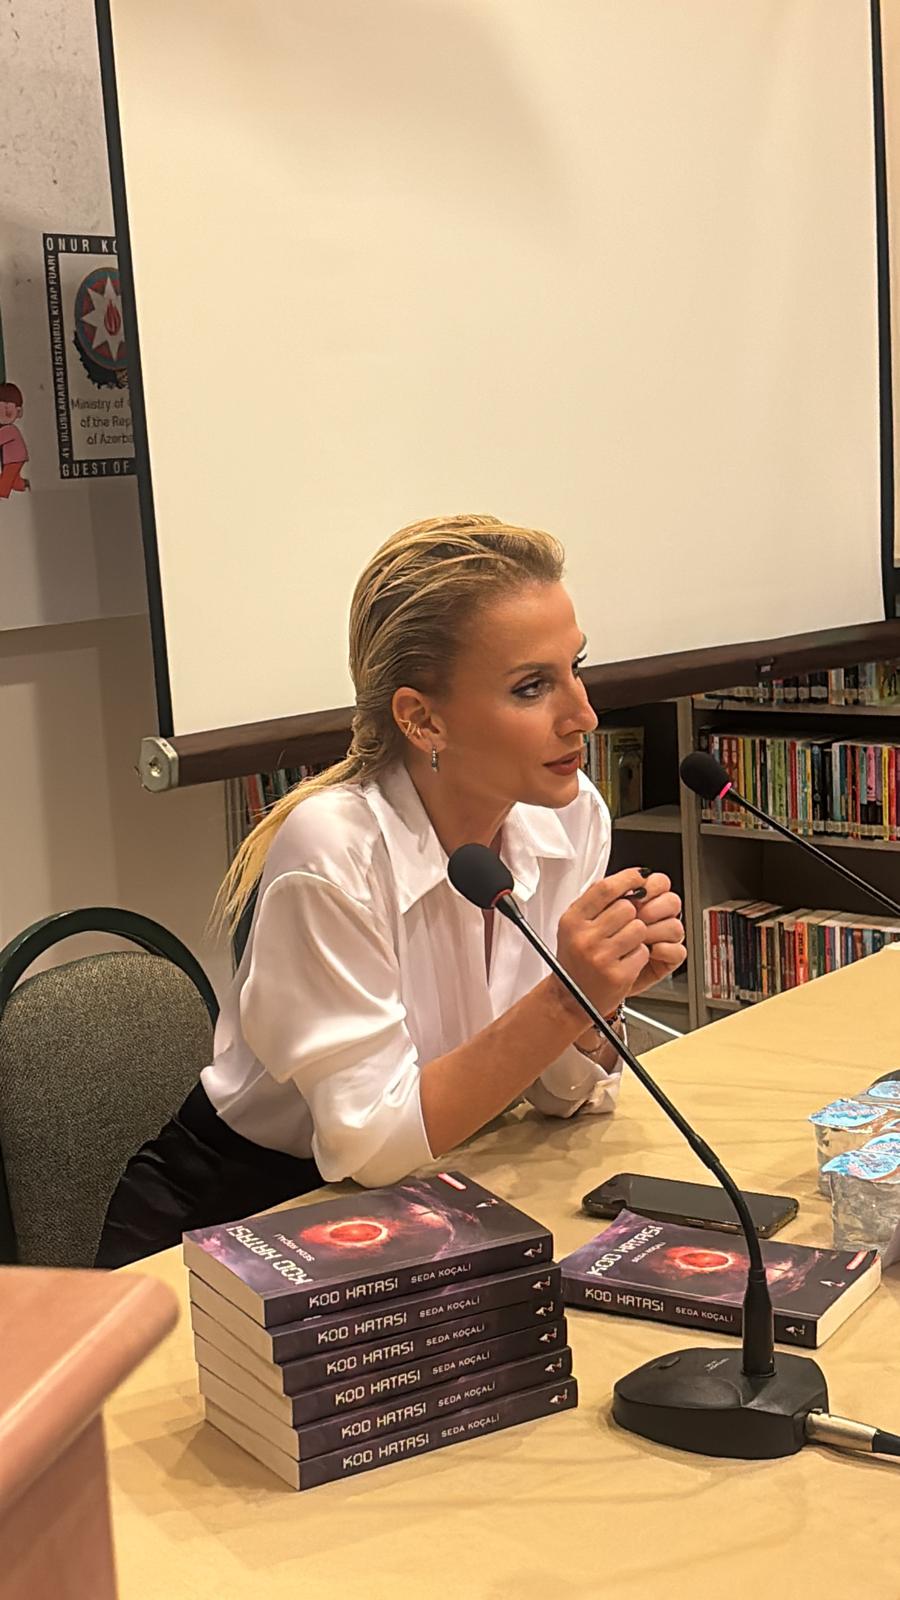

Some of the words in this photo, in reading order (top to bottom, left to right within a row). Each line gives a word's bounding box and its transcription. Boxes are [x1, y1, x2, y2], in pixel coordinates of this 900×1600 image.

[46, 237, 90, 252] ONUR
[47, 255, 57, 285] FUARI
[71, 398, 111, 412] Ministry
[114, 398, 123, 409] of
[80, 416, 90, 428] of
[93, 416, 109, 427] the
[86, 432, 97, 445] of
[62, 462, 107, 476] GUEST
[113, 461, 129, 473] OF
[225, 1225, 283, 1261] HATASI
[586, 1253, 623, 1277] KOD
[613, 1225, 664, 1253] HATASI
[272, 1259, 314, 1285] KOD
[309, 1291, 340, 1309] KOD
[346, 1278, 399, 1300] HATASI
[410, 1272, 436, 1284] SEDA
[585, 1287, 612, 1303] KOD
[617, 1294, 665, 1313] HATASI
[675, 1306, 699, 1317] SEDA
[317, 1326, 349, 1345] KOD
[354, 1312, 408, 1336] HATASI
[419, 1306, 444, 1318] SEDA
[326, 1356, 357, 1375] KOD
[362, 1341, 414, 1365] HATASI
[426, 1335, 450, 1347] SEDA
[335, 1388, 366, 1406] KOD
[370, 1369, 422, 1395] HATASI
[432, 1364, 456, 1375] SEDA
[341, 1419, 372, 1440] KOD
[376, 1402, 428, 1429] HATASI
[437, 1395, 462, 1408] SEDA
[342, 1452, 373, 1470] KOD
[378, 1433, 430, 1459] HATASI
[441, 1425, 466, 1438] SEDA
